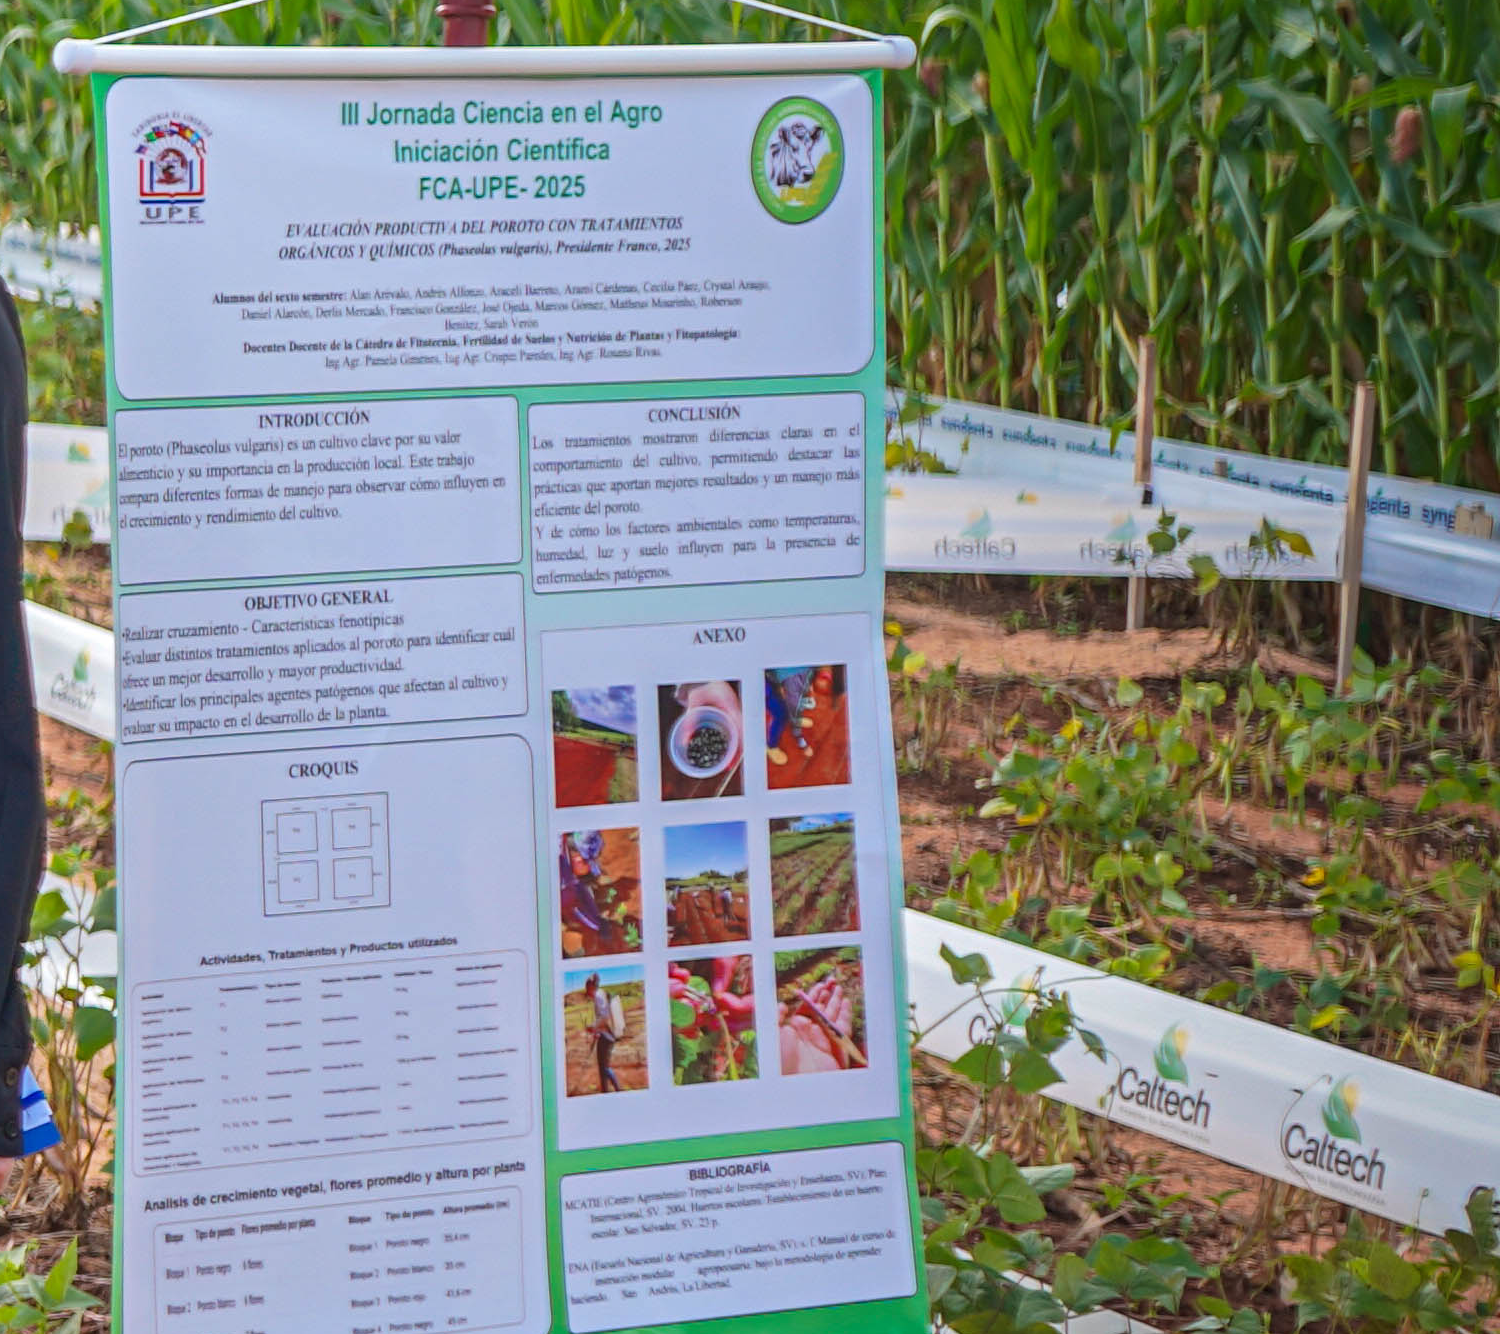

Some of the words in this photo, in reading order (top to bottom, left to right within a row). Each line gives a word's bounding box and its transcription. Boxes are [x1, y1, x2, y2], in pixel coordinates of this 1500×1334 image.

[341, 102, 359, 125] III
[366, 102, 455, 125] Jornada
[463, 100, 543, 123] Ciencia
[551, 106, 576, 123] en
[584, 100, 602, 122] el
[610, 100, 662, 128] Agro
[394, 139, 498, 162] Iniciación
[420, 175, 527, 199] FCA-UPE-
[534, 175, 585, 198] 2025
[145, 206, 200, 219] UPE
[286, 221, 369, 237] EVALUACIÓN
[374, 221, 456, 235] PRODUCTIVA
[461, 219, 485, 234] DEL
[490, 219, 544, 233] POROTO
[548, 218, 576, 231] CON
[581, 216, 682, 231] TRATAMIENTOS
[278, 243, 354, 259] ORGÁNICOS
[359, 244, 365, 258] Y
[369, 242, 434, 261] QUÍMICOS
[438, 242, 495, 256] (Phaseolus
[500, 242, 551, 257] vulgaris),
[556, 240, 613, 253] Presidente
[617, 239, 660, 252] Franco,
[664, 237, 690, 251] 2025
[259, 410, 369, 427] INTRODUCCIÓN
[648, 405, 740, 421] CONCLUSIÓN
[116, 443, 127, 459] El
[130, 445, 163, 460] poroto
[166, 440, 230, 456] (Phaseolus
[234, 438, 283, 455] vulgaris)
[286, 439, 298, 450] es
[302, 439, 315, 450] un
[318, 435, 358, 449] cultivo
[360, 433, 391, 447] clave
[394, 435, 414, 450] por
[418, 434, 430, 445] su
[434, 429, 460, 444] valor
[532, 435, 553, 449] Los
[564, 436, 631, 448] tratamientos
[642, 433, 698, 445] mostraron
[709, 428, 770, 442] diferencias
[780, 425, 812, 439] claras
[823, 427, 837, 437] en
[848, 422, 859, 436] el
[118, 466, 174, 481] alimenticio
[177, 468, 184, 482] y
[188, 467, 202, 478] su
[205, 464, 273, 480] importancia
[277, 463, 290, 474] en
[294, 459, 303, 473] la
[307, 458, 370, 475] producción
[374, 455, 404, 469] local.
[410, 453, 433, 468] Este
[436, 453, 474, 469] trabajo
[119, 492, 159, 507] compara
[162, 487, 220, 502] diferentes
[225, 485, 263, 499] formas
[266, 483, 279, 498] de
[284, 485, 324, 498] manejo
[328, 483, 352, 498] para
[355, 480, 405, 493] observar
[410, 477, 440, 491] cómo
[443, 474, 489, 491] influyen
[492, 476, 505, 487] en
[120, 514, 127, 529] el
[129, 514, 191, 527] crecimiento
[195, 514, 202, 528] y
[206, 509, 276, 523] rendimiento
[279, 505, 295, 520] del
[299, 505, 341, 519] cultivo.
[244, 593, 317, 610] OBJETIVO
[321, 589, 392, 605] GENERAL
[693, 627, 745, 643] ANEXO
[288, 760, 358, 778] CROQUIS
[200, 953, 264, 965] Actividades,
[268, 947, 337, 959] Tratamientos
[340, 946, 346, 957] y
[349, 941, 404, 952] Productos
[408, 937, 457, 948] utilizados
[1118, 1067, 1212, 1128] Caltech
[1284, 1123, 1387, 1191] Caltech
[688, 1162, 770, 1180] BIBLIOGRAFÍA
[144, 1197, 188, 1211] Analisis
[192, 1194, 206, 1206] de
[210, 1188, 277, 1203] crecimiento
[281, 1181, 326, 1198] vegetal,
[330, 1179, 363, 1191] flores
[366, 1172, 422, 1189] promedio
[425, 1172, 431, 1185] y
[435, 1168, 468, 1180] altura
[472, 1166, 490, 1179] por
[494, 1161, 525, 1176] planta
